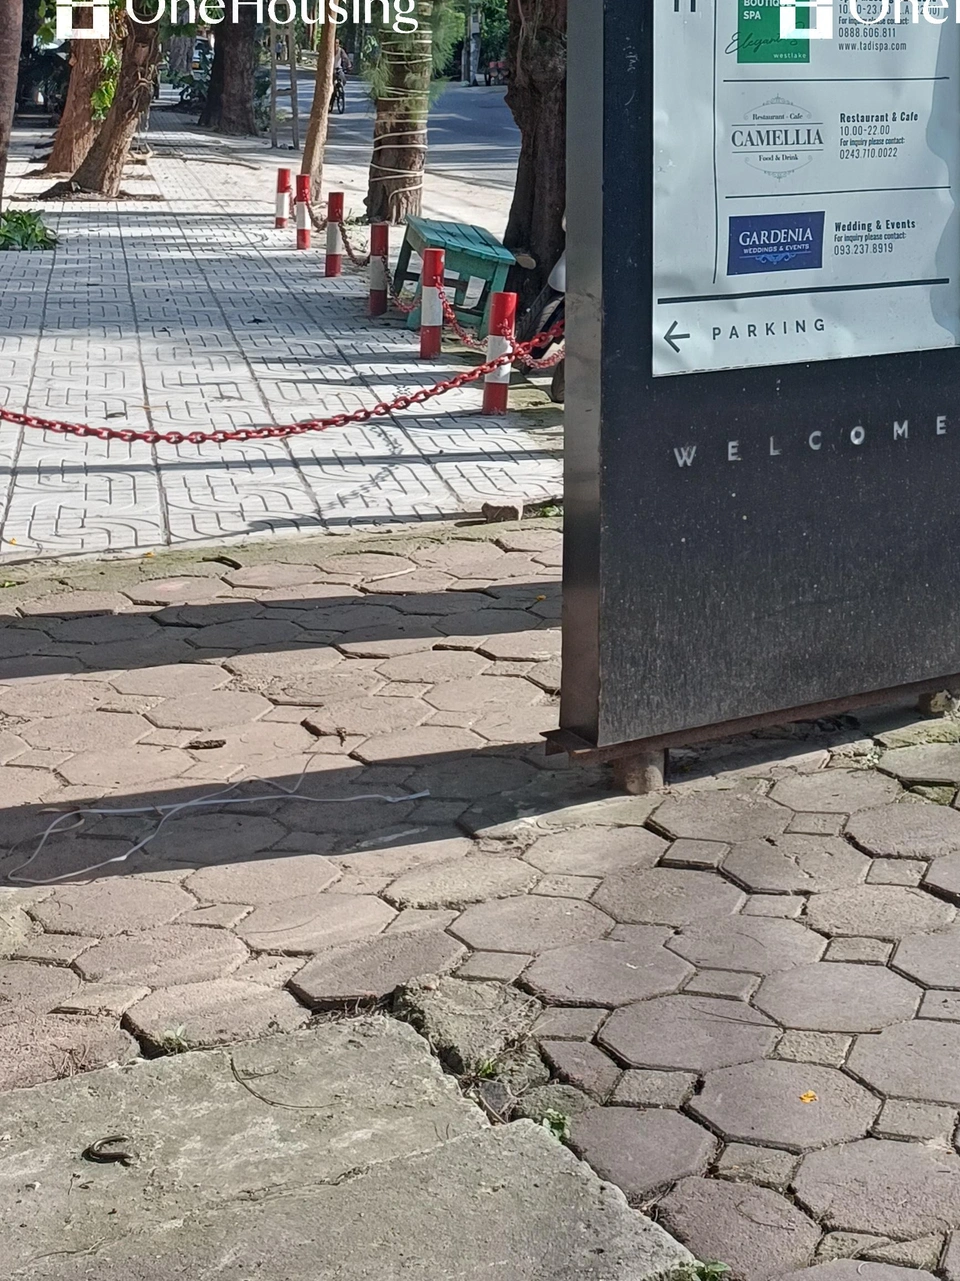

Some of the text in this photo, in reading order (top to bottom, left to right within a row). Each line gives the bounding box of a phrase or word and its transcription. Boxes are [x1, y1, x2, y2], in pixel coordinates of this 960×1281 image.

[743, 10, 761, 20] SPA
[838, 16, 848, 24] For
[839, 27, 896, 38] 0888.606.811
[838, 41, 907, 52] www.tadispa.com
[789, 112, 804, 120] Cafe
[840, 111, 919, 123] Restaurant & Cafe
[840, 124, 890, 136] 10.00-22.00
[731, 128, 824, 147] CAMELLIA
[840, 138, 849, 146] For
[839, 147, 898, 160] 0243.710.0022
[834, 219, 916, 232] Wedding & Events
[739, 227, 813, 246] GARDENIA
[834, 234, 843, 242] For
[864, 233, 883, 242] please
[743, 246, 777, 254] WEDDINGS
[785, 243, 810, 251] EVENTS
[834, 242, 893, 256] 093.237.8919
[712, 318, 825, 341] PARKING
[673, 415, 948, 468] WELCOME
